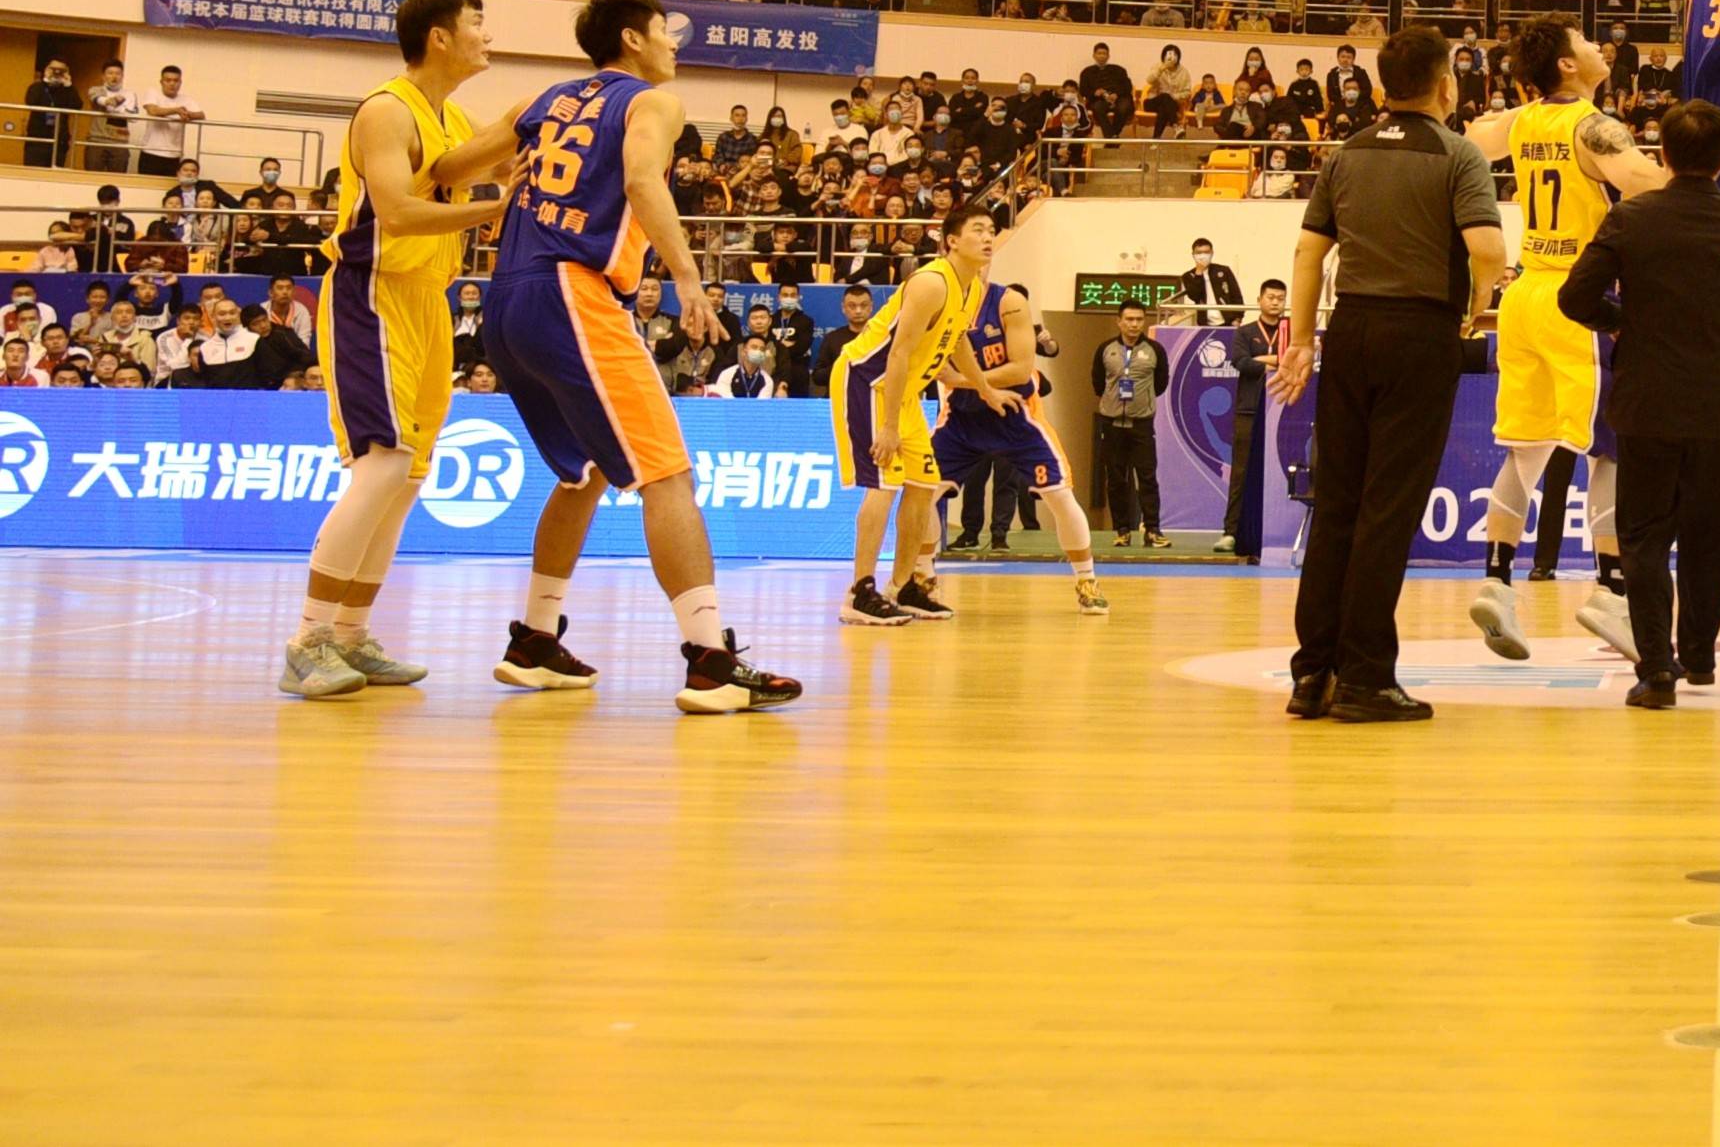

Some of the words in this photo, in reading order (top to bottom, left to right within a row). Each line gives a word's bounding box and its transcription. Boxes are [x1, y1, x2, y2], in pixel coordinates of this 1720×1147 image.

[706, 24, 818, 51] 益阳高发投
[1528, 168, 1562, 231] 17
[1079, 281, 1177, 306] 安全出口
[67, 441, 353, 502] 大瑞消防
[1034, 464, 1049, 486] 8
